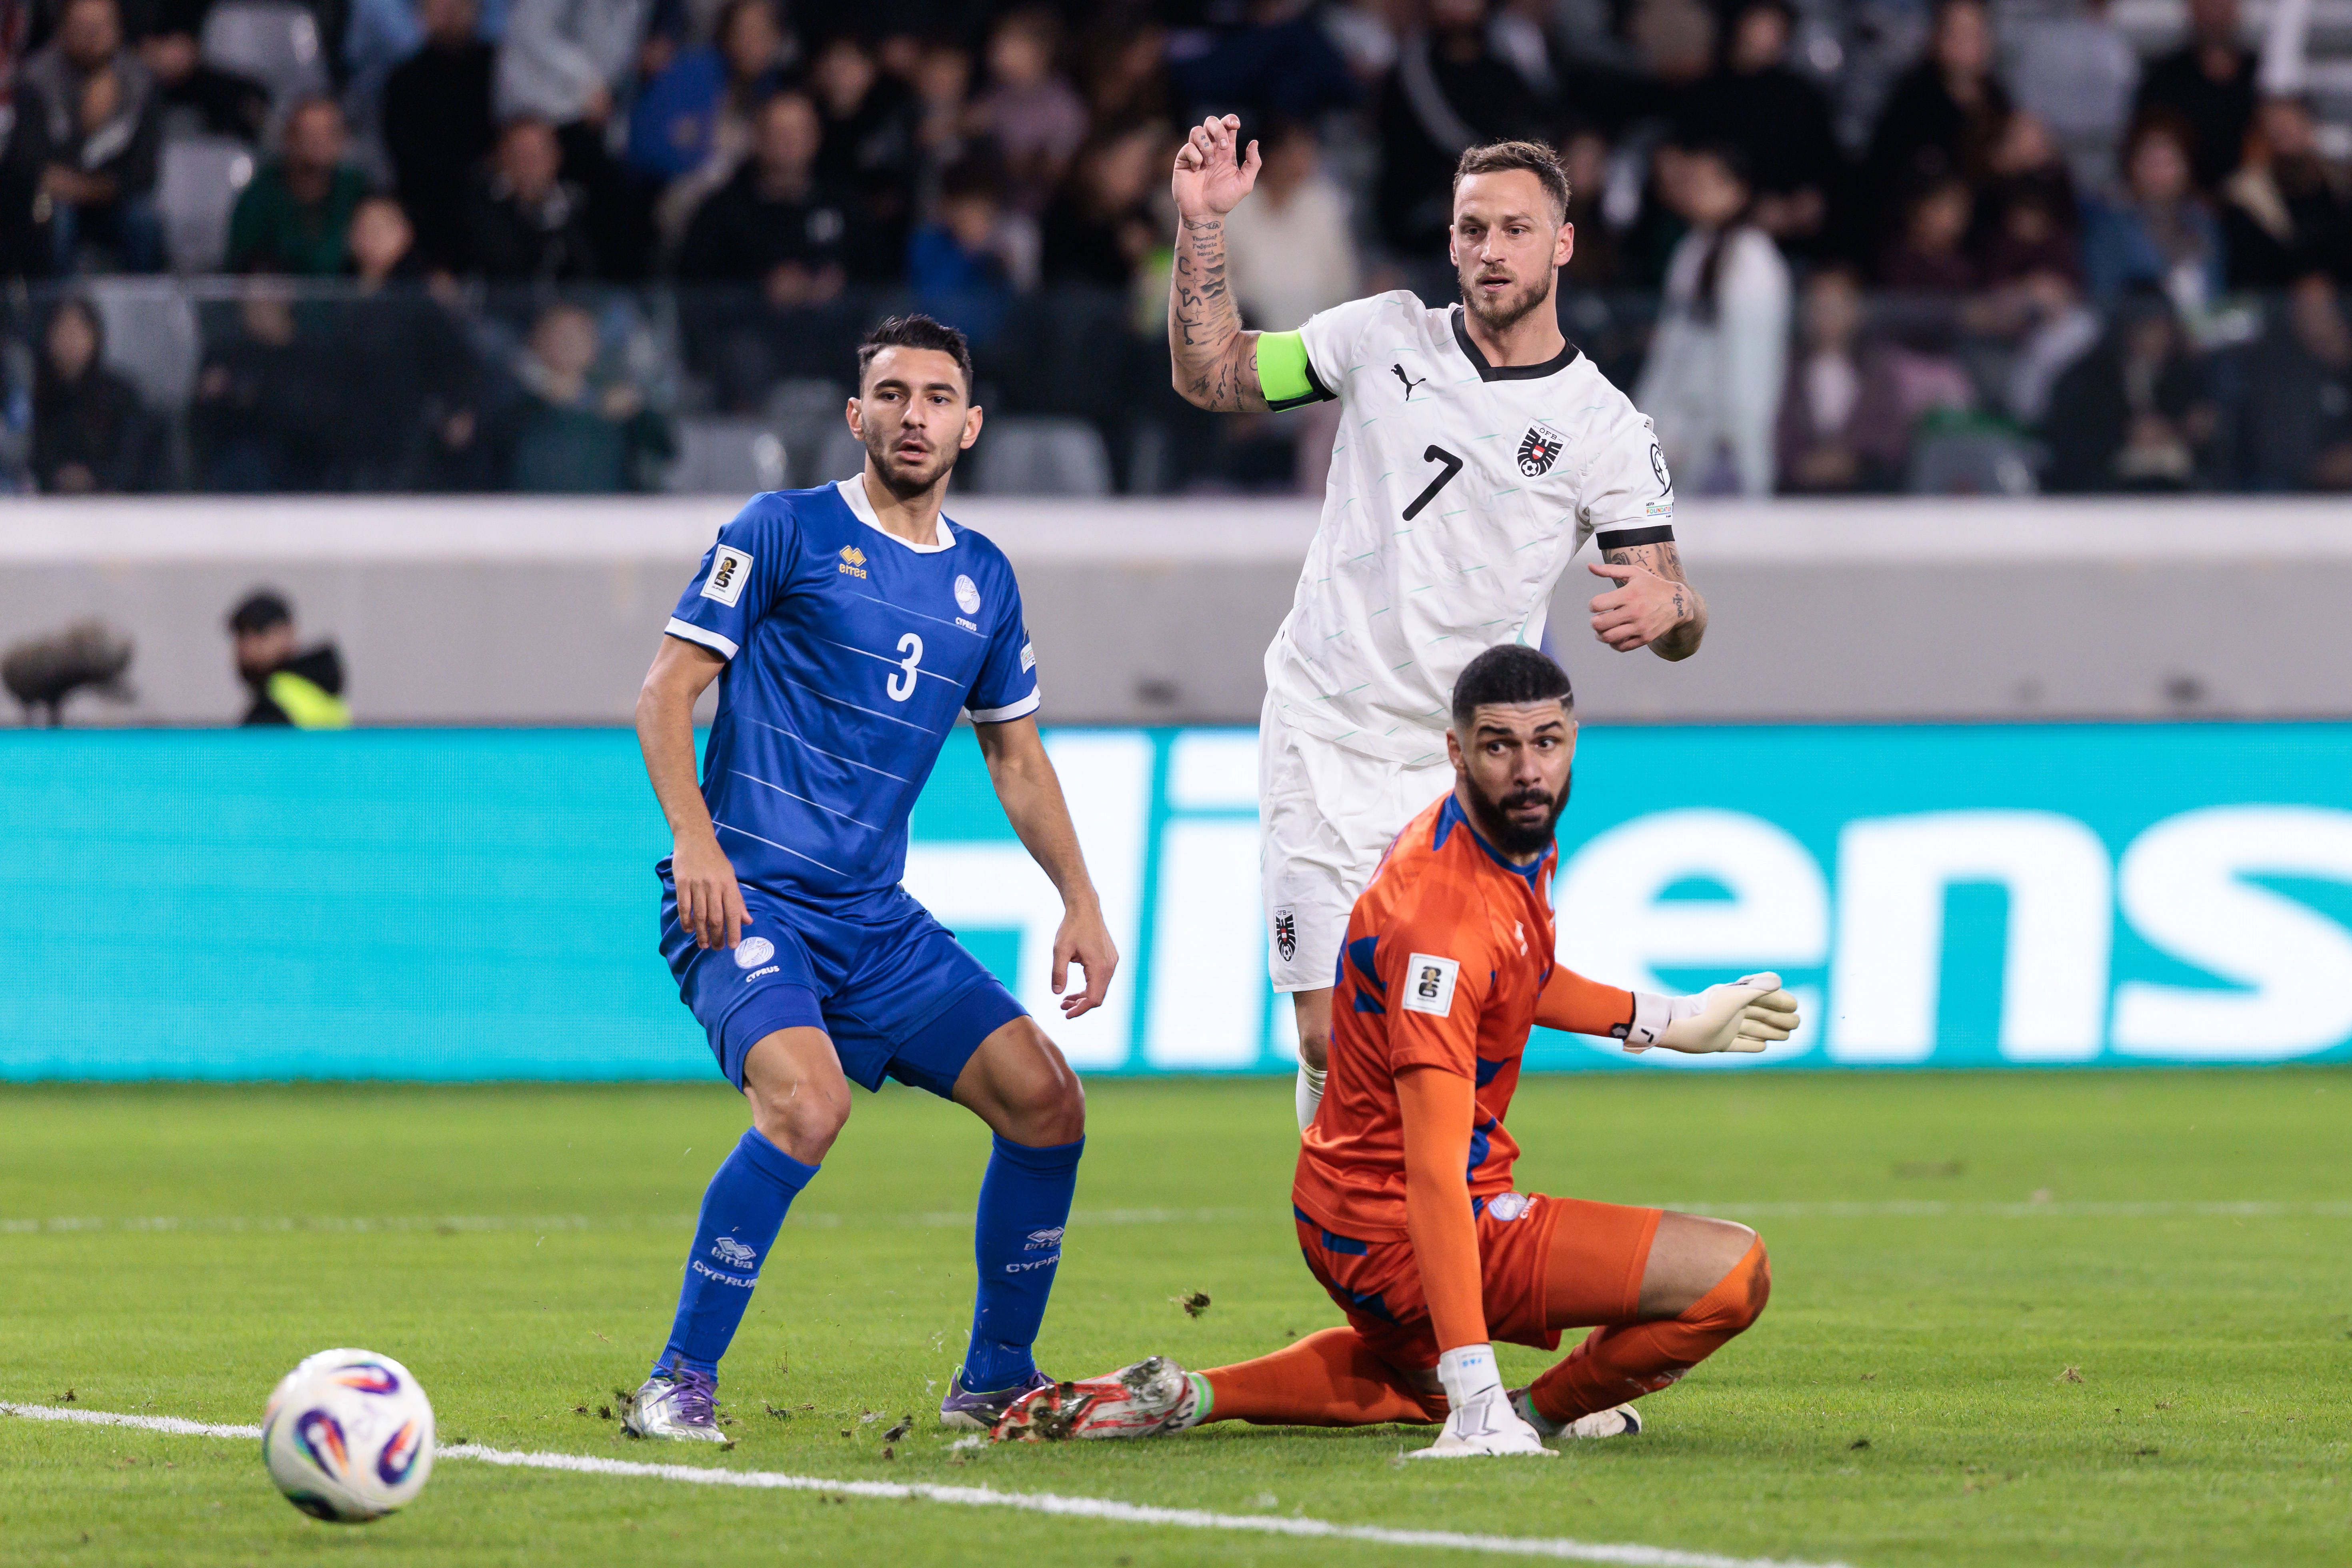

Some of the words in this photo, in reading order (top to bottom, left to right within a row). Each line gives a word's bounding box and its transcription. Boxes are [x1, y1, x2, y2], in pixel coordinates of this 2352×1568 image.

[1540, 427, 1557, 440] ÖFB
[1402, 444, 1463, 521] 7
[955, 616, 977, 632] CYPRUS
[886, 632, 924, 702] 3
[746, 965, 780, 982] CYPRUS
